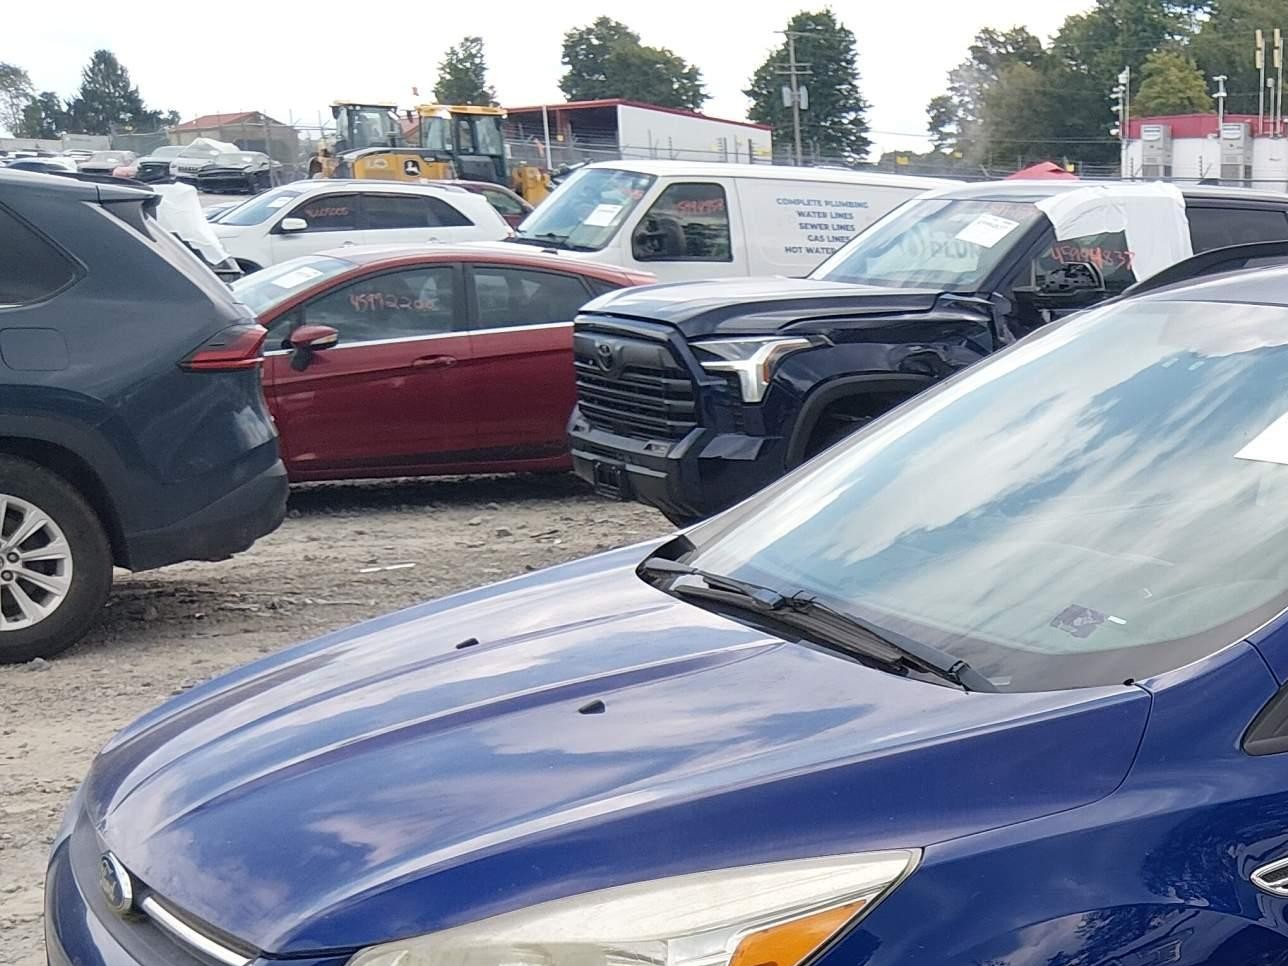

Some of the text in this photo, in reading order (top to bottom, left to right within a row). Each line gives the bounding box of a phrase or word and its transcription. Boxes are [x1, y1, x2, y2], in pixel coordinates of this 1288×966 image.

[776, 198, 869, 208] COMPLETE PLUMBING
[797, 211, 854, 220] WATER LINES
[799, 223, 856, 232] SEWER LINES
[827, 235, 851, 243] LINES
[785, 246, 803, 254] HOT
